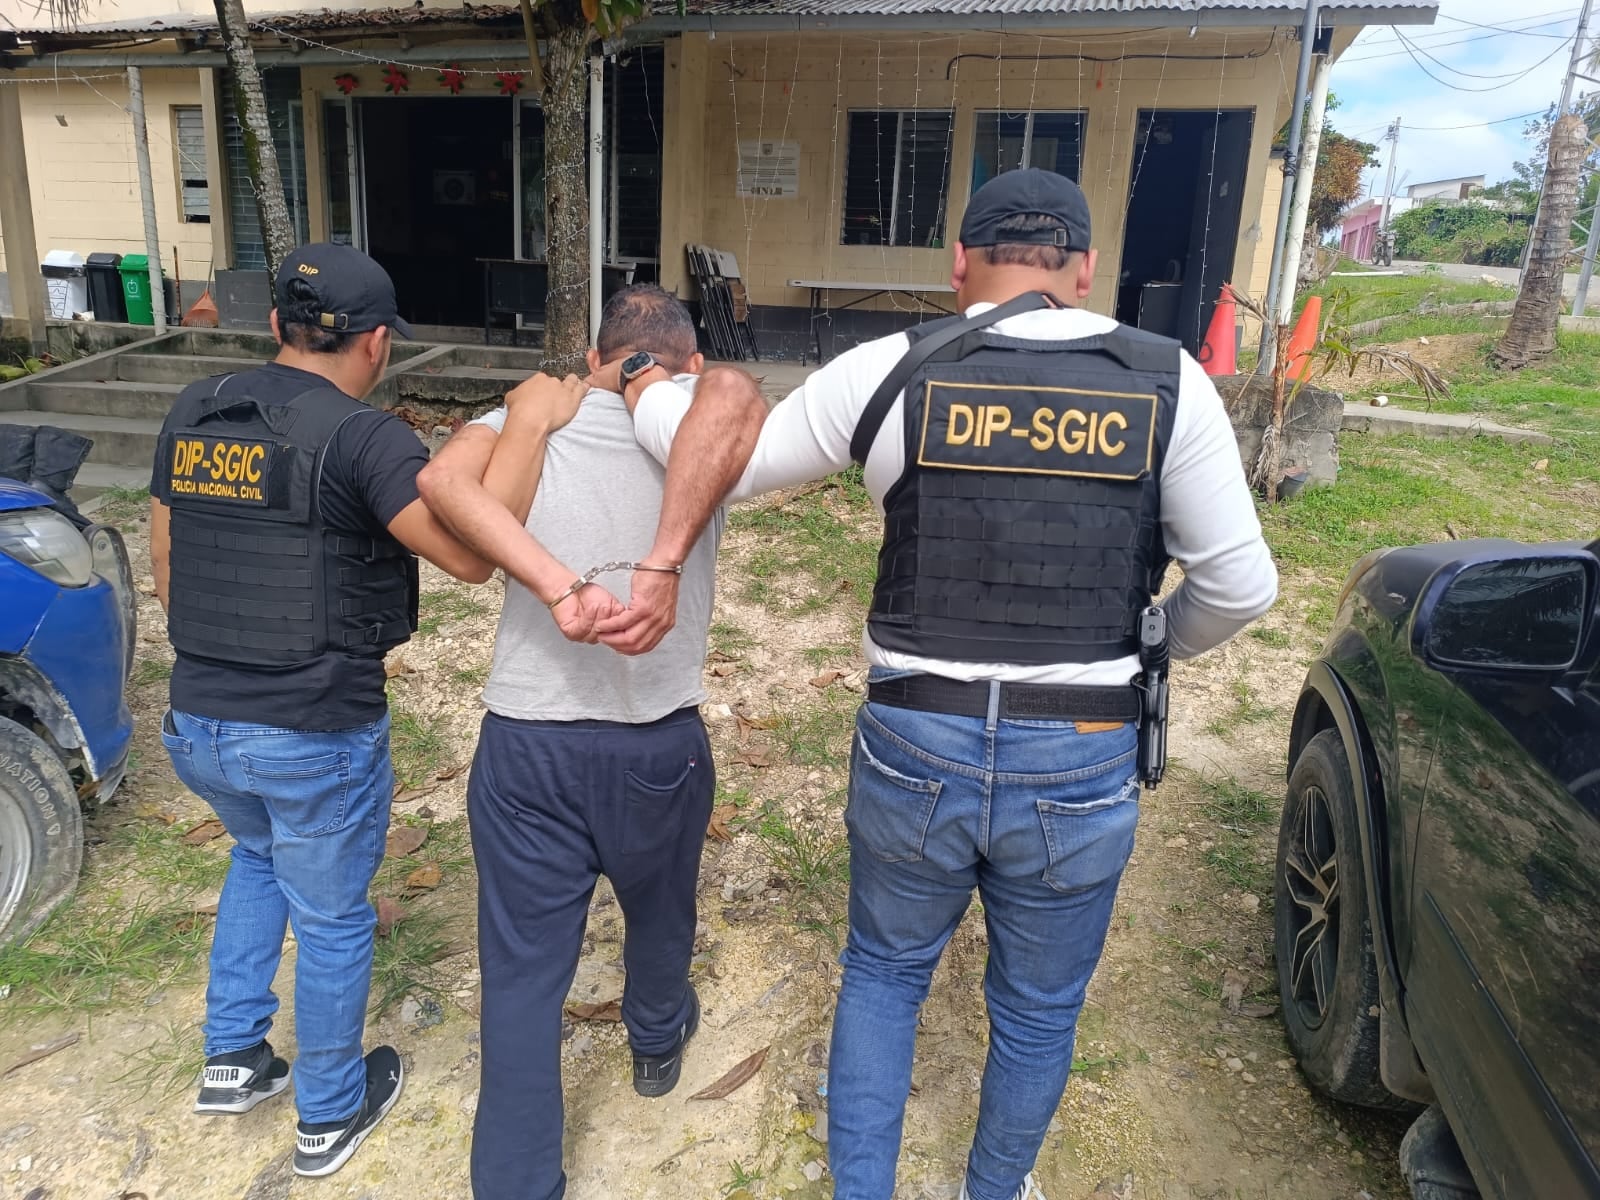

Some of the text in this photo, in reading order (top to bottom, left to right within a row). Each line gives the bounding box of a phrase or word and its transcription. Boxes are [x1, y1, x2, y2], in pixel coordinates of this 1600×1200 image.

[298, 264, 319, 276] DIP
[946, 403, 1128, 457] DIP-SGIC
[173, 440, 265, 483] DIP-SGIC
[171, 479, 263, 500] POLICIA NACIONAL CIVIL
